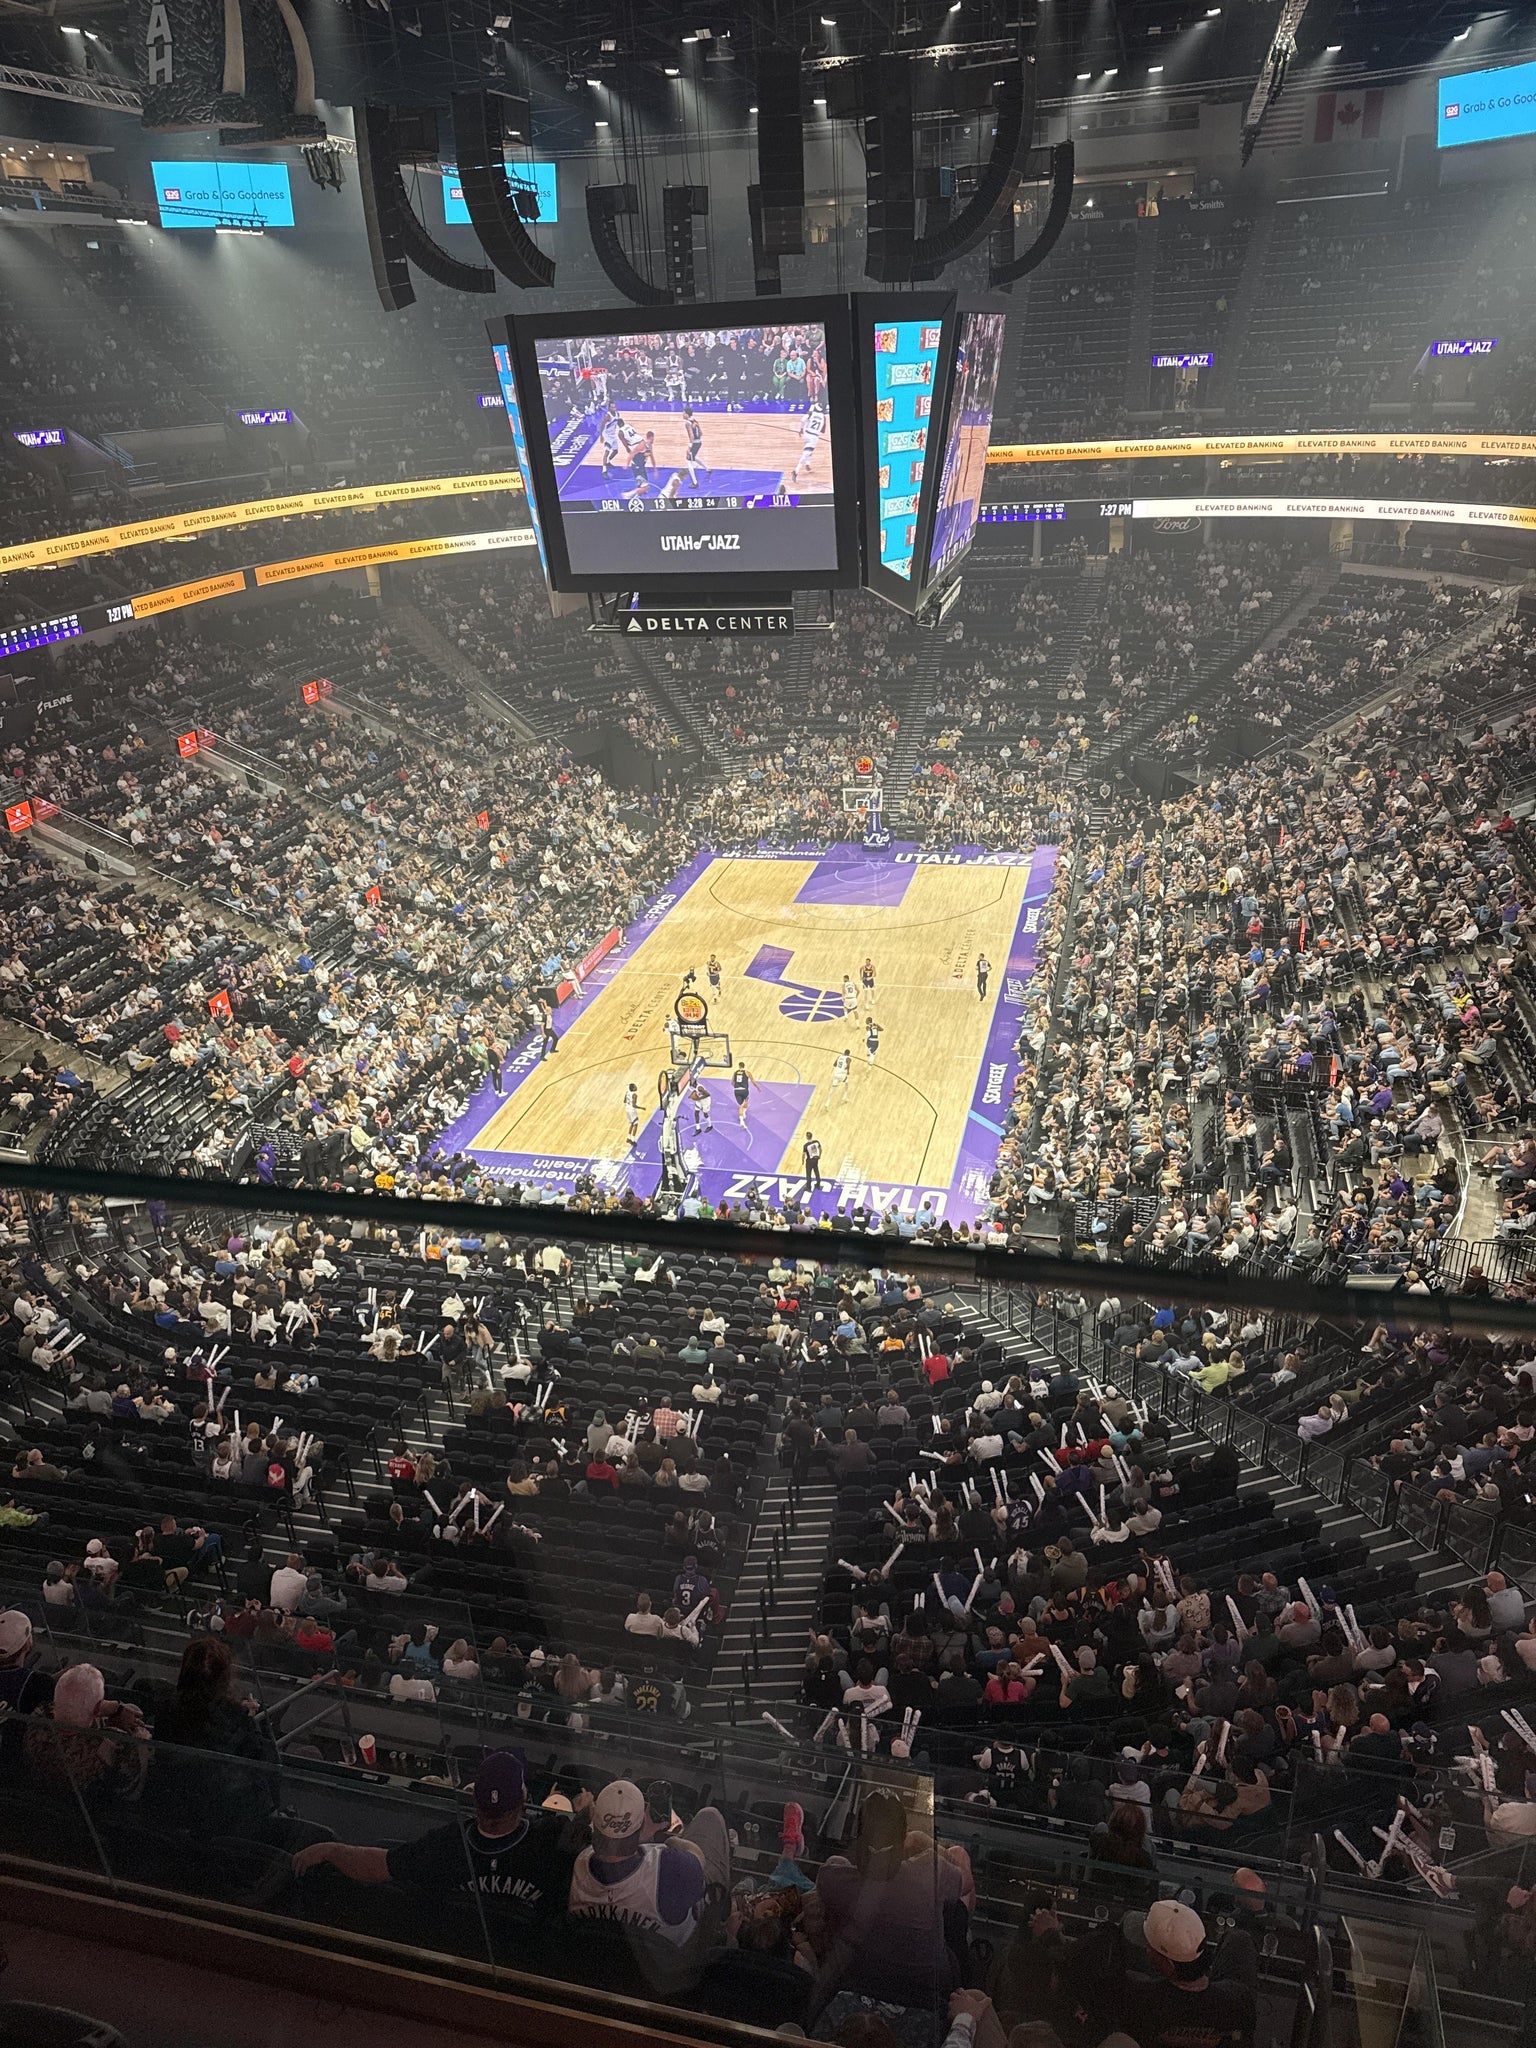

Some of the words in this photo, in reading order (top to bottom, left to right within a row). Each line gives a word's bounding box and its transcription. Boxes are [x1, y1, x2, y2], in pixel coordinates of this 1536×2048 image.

[146, 4, 173, 85] AH
[1464, 101, 1486, 114] Grab
[1488, 99, 1495, 110] &
[1498, 97, 1511, 108] Go
[185, 190, 209, 200] Grab
[212, 190, 219, 200] &
[221, 190, 236, 200] Go
[238, 190, 285, 200] Goodness
[1437, 343, 1459, 354] UTAH
[1469, 342, 1492, 353] JAZZ
[1157, 357, 1178, 367] UTAH
[1188, 355, 1209, 366] JAZZ
[482, 396, 501, 407] UTAH
[242, 413, 261, 425] UTAH
[269, 411, 287, 423] JAZZ
[44, 431, 61, 444] JAZZ
[1298, 440, 1338, 448] ELEVATED
[1389, 440, 1430, 448] ELEVATED
[1431, 440, 1467, 448] BANKING
[1027, 448, 1065, 456] ELEVATED
[1067, 447, 1102, 455] BANKING
[1115, 445, 1154, 453] ELEVATED
[1155, 443, 1192, 451] BANKING
[1205, 442, 1246, 450] ELEVATED
[1247, 441, 1284, 449] BANKING
[1481, 441, 1520, 450] ELEVATED
[453, 480, 488, 489] ELEVATED
[488, 477, 521, 486] BANKING
[375, 488, 410, 498] ELEVATED
[411, 485, 441, 494] BANKING
[313, 495, 347, 505] ELEVATED
[602, 499, 620, 511] DEN
[654, 499, 665, 510] 13
[706, 499, 715, 507] 24
[726, 497, 737, 507] 18
[772, 497, 791, 507] UTA
[245, 505, 276, 516] ELEVATED
[276, 500, 304, 511] BANKING
[1100, 504, 1117, 516] 7:27
[1119, 503, 1132, 515] PM
[1287, 504, 1327, 512] ELEVATED
[1329, 505, 1365, 513] BANKING
[1378, 507, 1418, 515] ELEVATED
[1420, 508, 1455, 517] BANKING
[183, 516, 211, 528] ELEVATED
[211, 511, 237, 522] BANKING
[1153, 517, 1190, 531] Ford
[1469, 511, 1508, 520] ELEVATED
[1509, 514, 1536, 523] BANKIN
[119, 528, 149, 540] ELEVATED
[150, 523, 176, 534] BANKING
[46, 542, 80, 555] ELEVATED
[81, 536, 110, 548] BANKING
[410, 544, 443, 554] ELEVATED
[444, 539, 476, 549] BANKING
[488, 536, 523, 545] ELEVATED
[661, 535, 693, 551] UTAH
[708, 534, 740, 550] JAZZ
[2, 551, 35, 564] BANKING
[334, 554, 367, 565] ELEVATED
[368, 550, 399, 560] BANKING
[265, 566, 296, 578] ELEVATED
[296, 561, 324, 573] BANKING
[183, 587, 210, 600] ELEVATED
[210, 580, 235, 592] BANKING
[134, 603, 149, 613] ATED
[149, 595, 175, 608] BANKING
[106, 607, 121, 623] 7:27
[121, 603, 133, 619] PM
[646, 617, 710, 631] DELTA
[716, 616, 788, 630] CENTER
[894, 853, 962, 865] UTAH
[965, 854, 1035, 866] JAZZ
[648, 893, 677, 916] PACS
[954, 952, 969, 973] DELTA
[628, 1009, 653, 1034] DELTA
[648, 982, 671, 1009] CENTER
[982, 1062, 1009, 1105] SEATGEEK
[532, 1158, 588, 1173] Health
[723, 1173, 834, 1206] JAZZ
[837, 1183, 948, 1216] UTAH
[193, 1438, 205, 1452] 13
[1012, 1515, 1029, 1530] 45
[682, 1590, 691, 1606] 3
